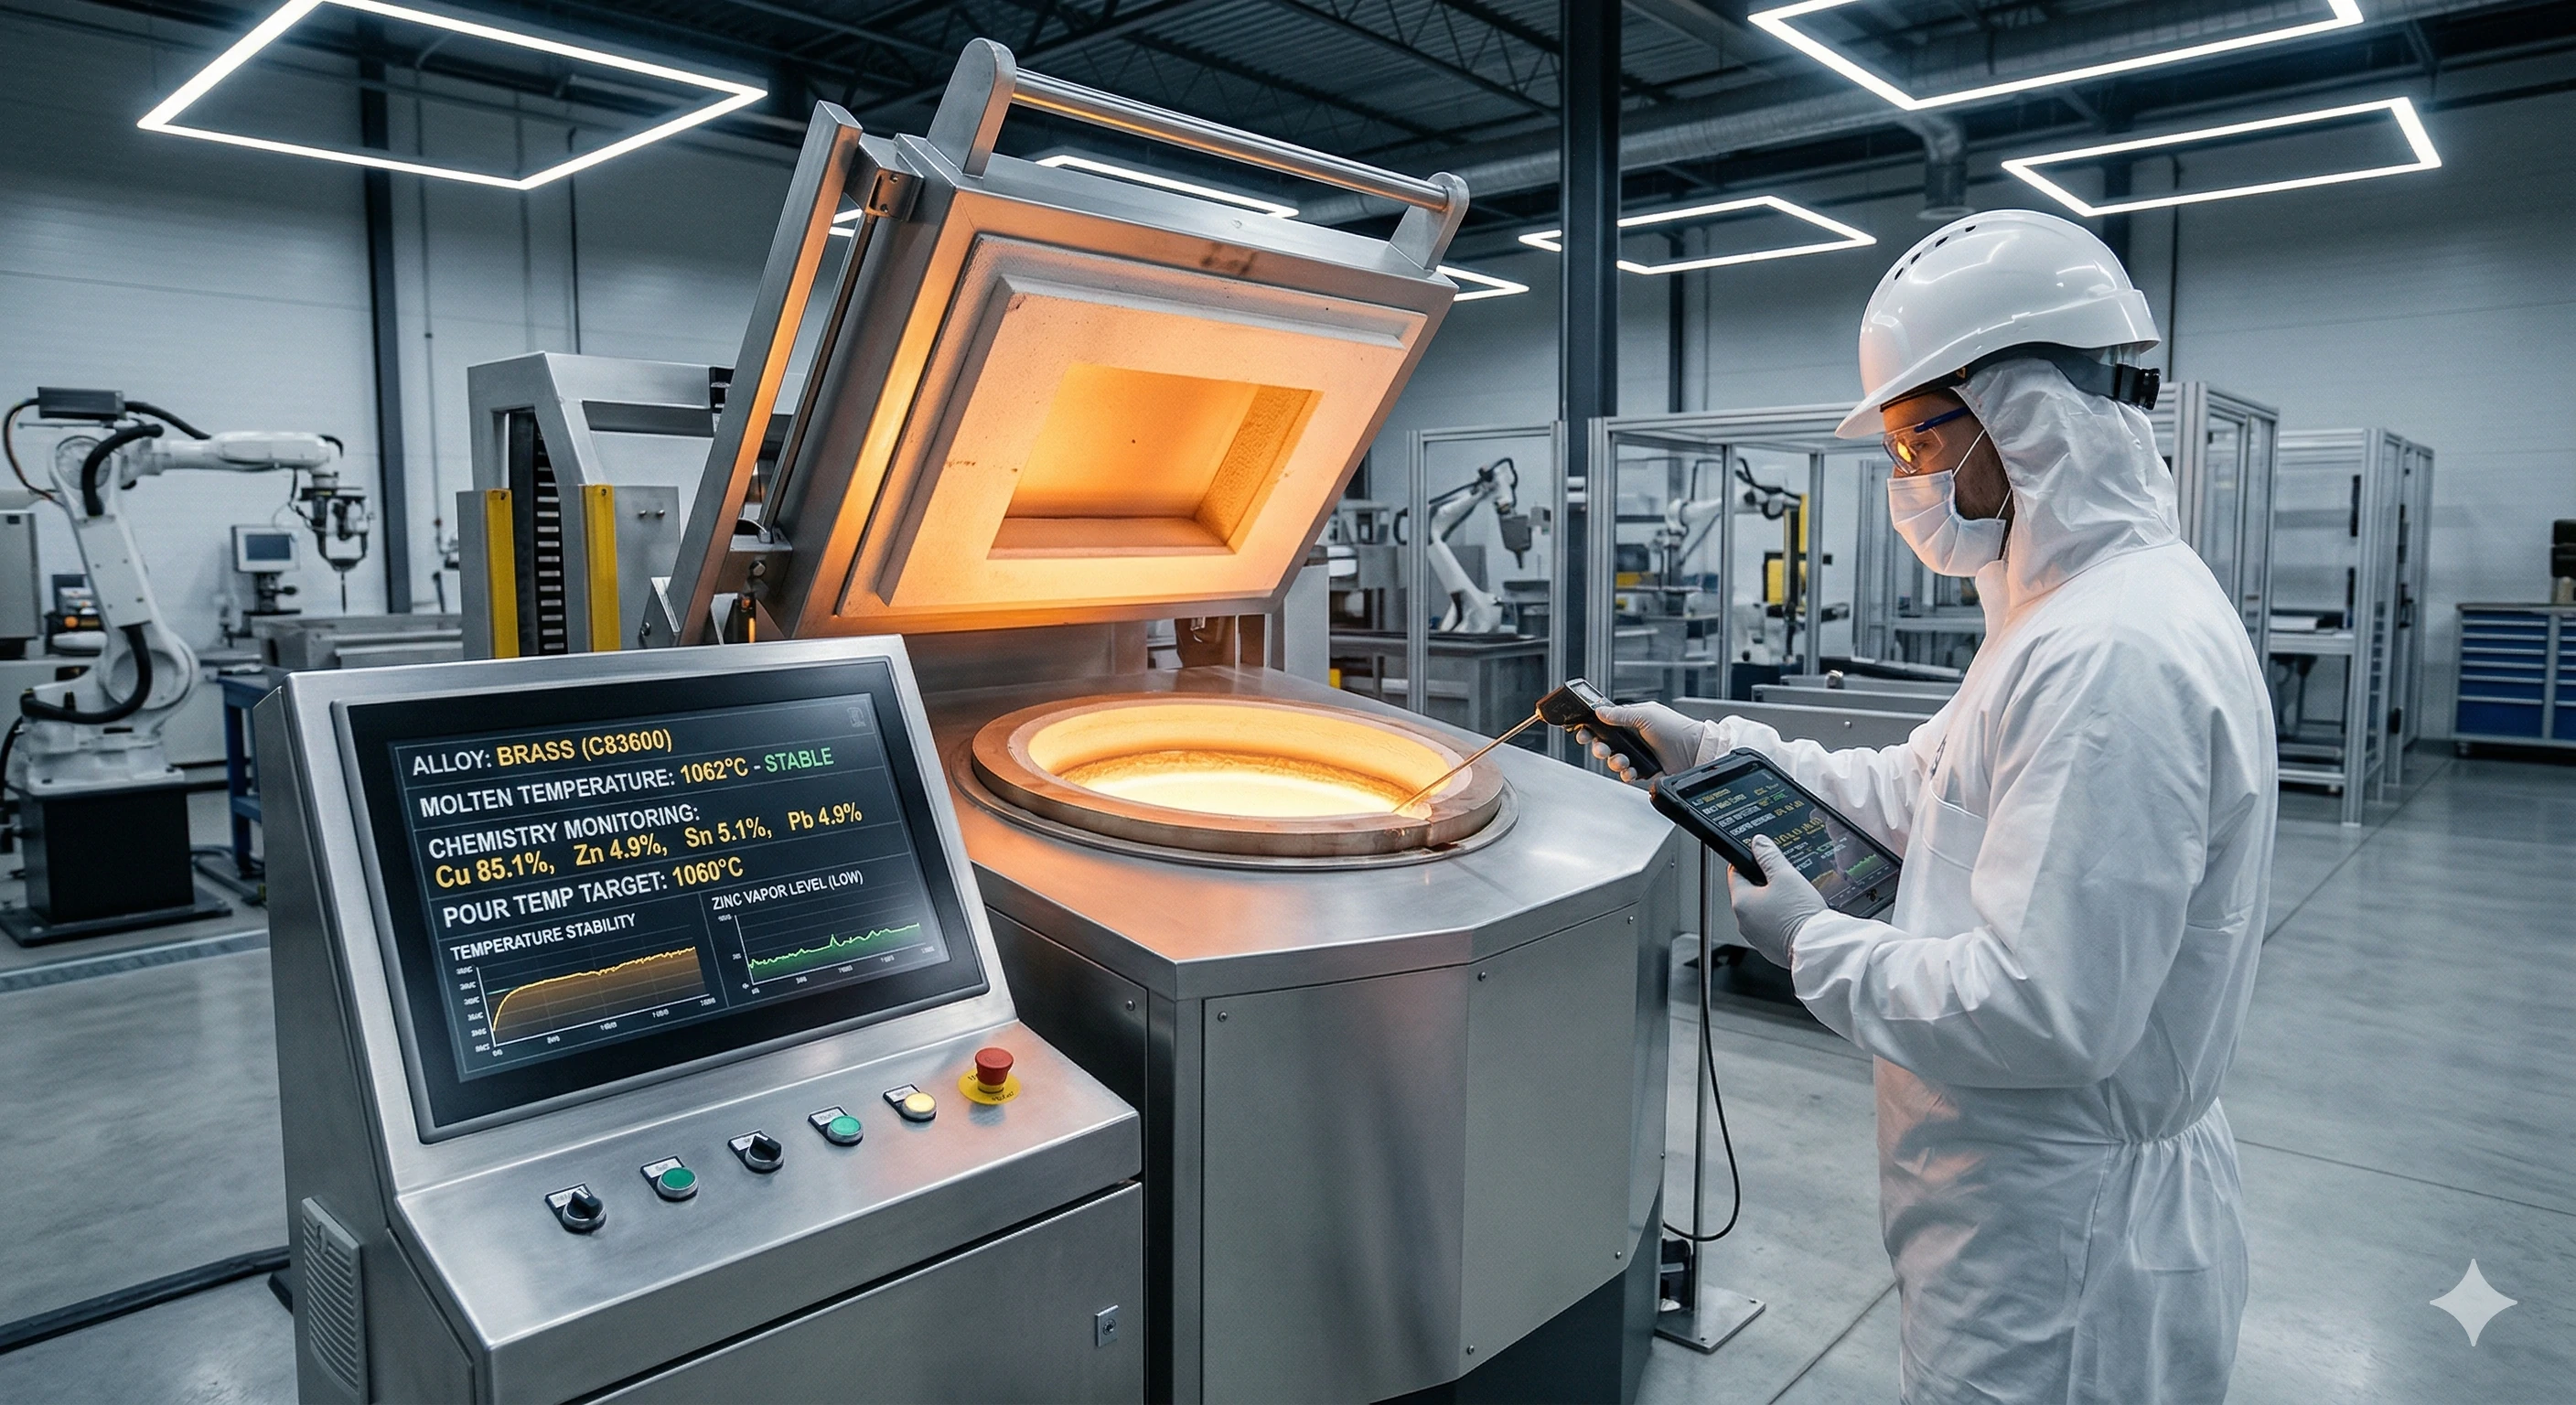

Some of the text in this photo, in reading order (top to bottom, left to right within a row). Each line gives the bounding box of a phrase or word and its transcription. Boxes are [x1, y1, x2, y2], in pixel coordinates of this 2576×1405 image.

[413, 729, 672, 776] ALLOY: BRASS (C83600)
[419, 788, 513, 818] MOLTEN
[517, 768, 675, 804] TEMPERATURE:
[680, 756, 749, 784] 1062°C
[764, 747, 834, 773] STABLE
[428, 803, 700, 859] CHEMISTRY MONITORING:
[435, 801, 863, 888] Cu 85.1%, Zn 4.9%, Sn 5.1%, Pb 4.9%
[443, 856, 744, 928] POUR TEMP TARGET: 1060°C
[712, 869, 864, 910] ZINC VAPOR LEVEL (LOW)
[449, 913, 636, 960] TEMPERATURE STABILITY
